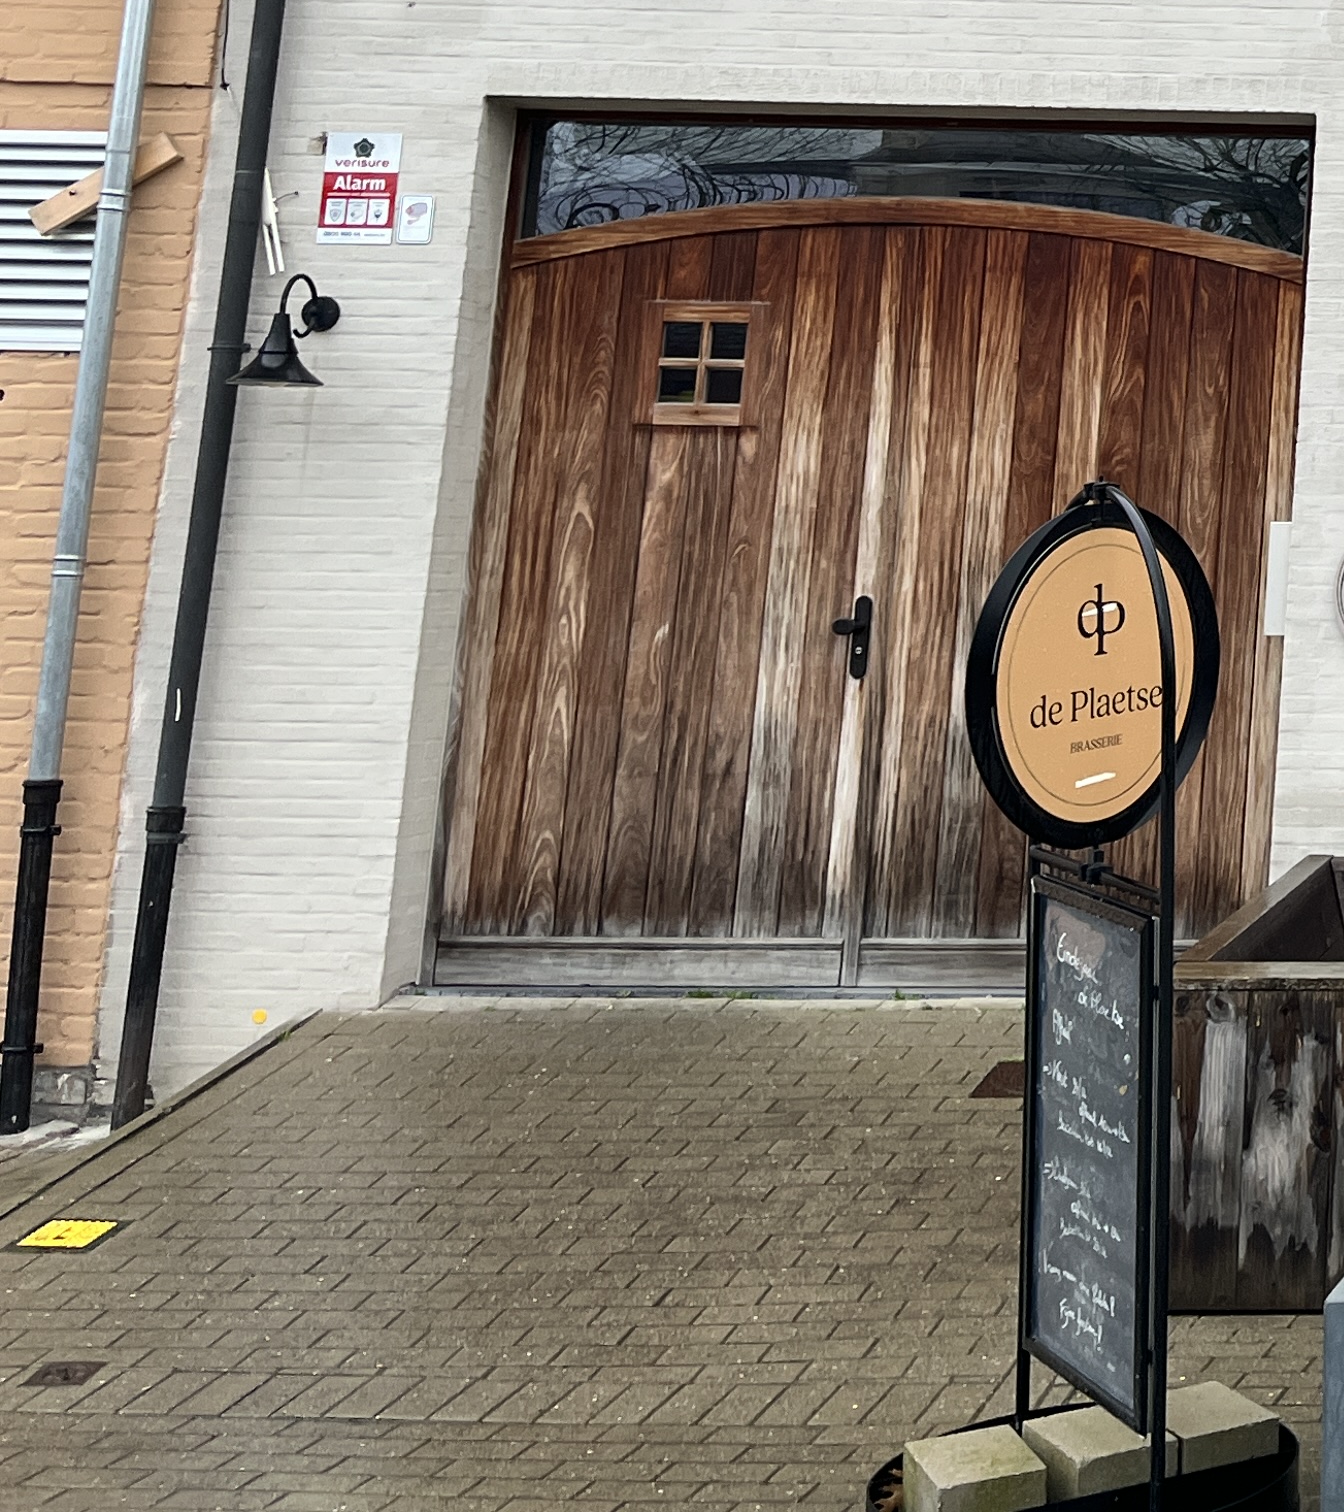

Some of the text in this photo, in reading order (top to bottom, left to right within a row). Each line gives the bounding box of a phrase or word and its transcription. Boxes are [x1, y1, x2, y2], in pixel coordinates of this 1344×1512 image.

[334, 159, 390, 168] verisure
[333, 175, 386, 191] Alarm
[1029, 684, 1165, 729] de Plaetse
[1069, 732, 1123, 755] BRASSERIE
